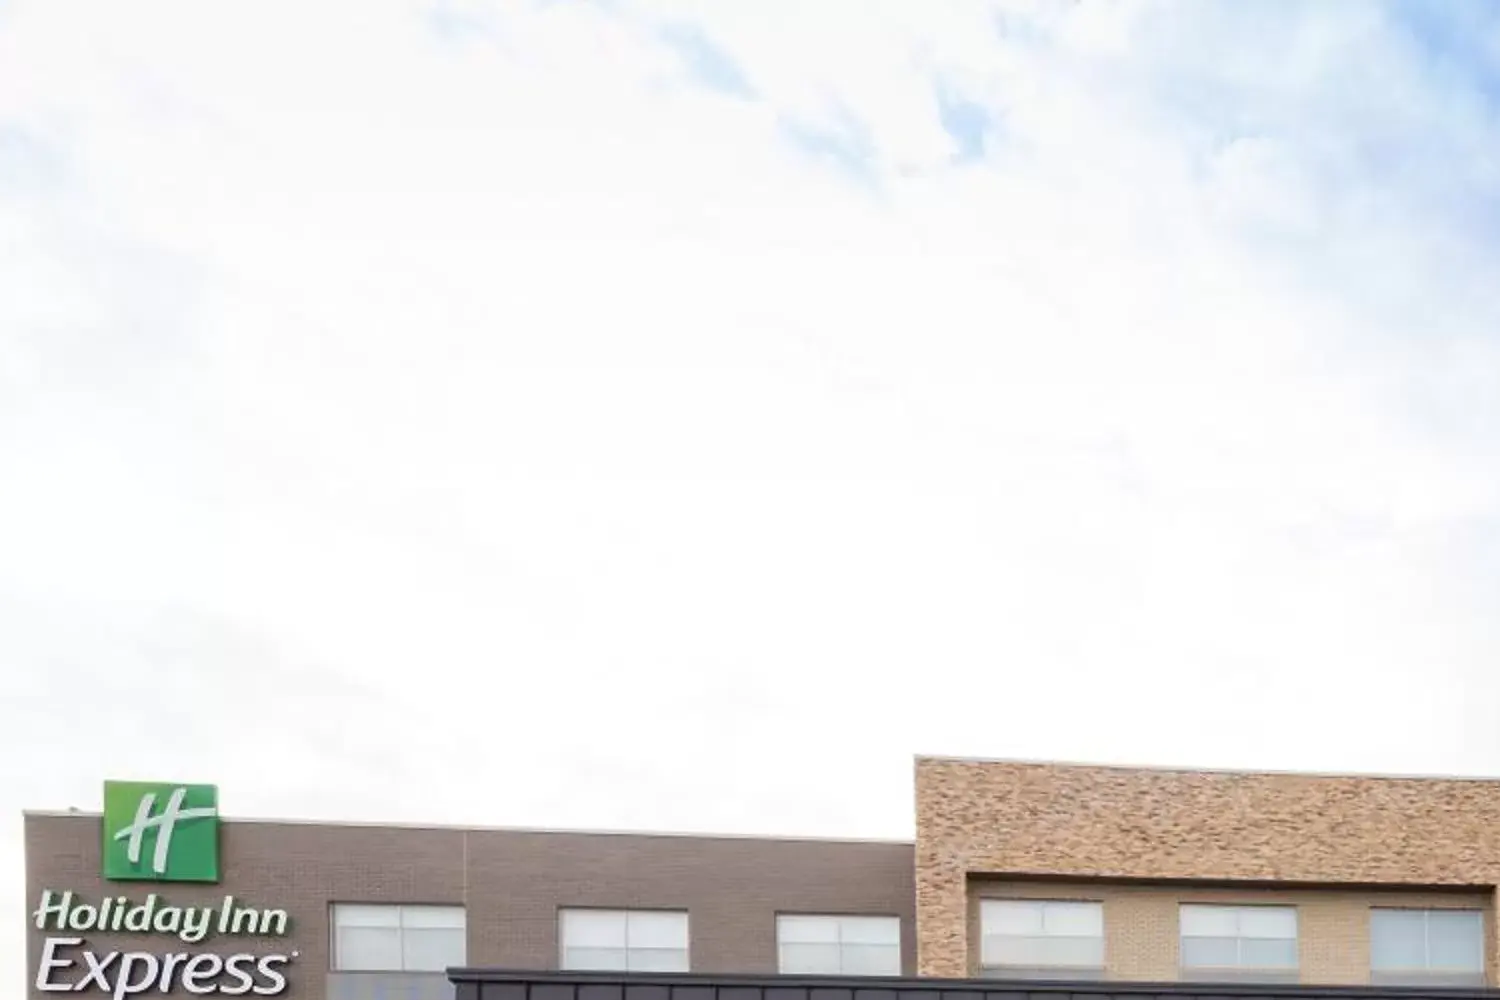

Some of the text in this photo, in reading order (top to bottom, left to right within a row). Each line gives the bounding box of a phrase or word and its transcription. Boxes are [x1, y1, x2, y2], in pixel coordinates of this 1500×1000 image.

[114, 788, 216, 873] H
[33, 889, 289, 943] Holiday Inn
